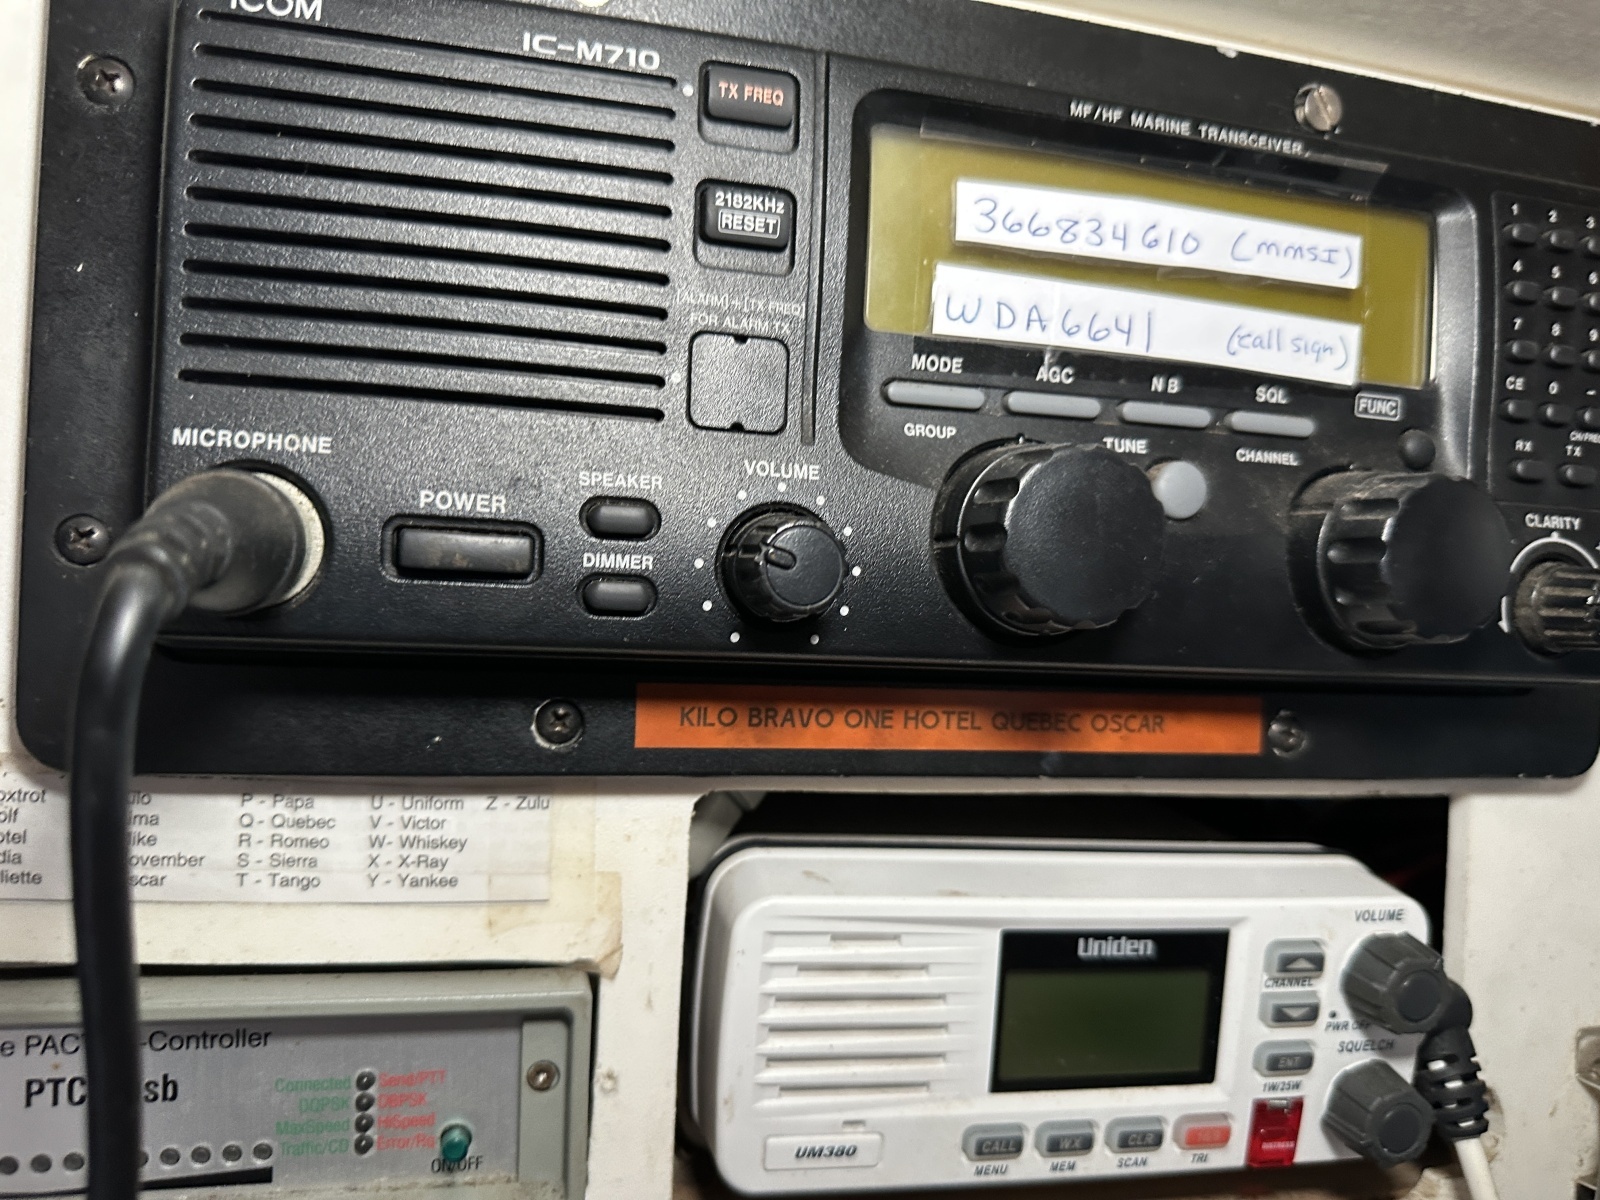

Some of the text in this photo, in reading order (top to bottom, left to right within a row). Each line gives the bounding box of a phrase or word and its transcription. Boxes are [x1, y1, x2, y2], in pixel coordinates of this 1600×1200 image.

[522, 32, 660, 70] IC-M710
[719, 81, 784, 106] TX FREQ
[1130, 109, 1193, 136] MARINE
[1198, 122, 1304, 155] TRANSCEIVER
[1511, 203, 1519, 215] 1
[1548, 209, 1558, 223] 2
[721, 212, 777, 234] RESET
[1586, 216, 1596, 229] 3
[1512, 259, 1523, 272] 4
[1551, 265, 1561, 279] 5
[1589, 271, 1598, 285] 6
[690, 312, 719, 326] FOR
[722, 315, 769, 333] ALARM
[1513, 317, 1523, 330] 7
[1551, 322, 1562, 336] 8
[1589, 328, 1599, 342] 9
[911, 354, 962, 374] MODE
[1035, 366, 1073, 385] AGC
[1506, 375, 1525, 391] CE
[1255, 386, 1287, 405] SQL
[1359, 397, 1395, 416] FUNC
[903, 423, 956, 440] GROUP
[172, 428, 331, 454] MICROPHONE
[1104, 437, 1148, 454] TUNE
[1515, 439, 1533, 452] RX
[1236, 449, 1298, 467] CHANNEL
[1565, 444, 1582, 457] TX
[744, 461, 820, 481] VOLUME
[579, 470, 664, 490] SPEAKER
[420, 491, 506, 514] POWER
[1525, 513, 1581, 531] CLARITY
[582, 552, 654, 571] DIMMER
[680, 706, 1165, 735] KILO BRAVO ONE HOTEL QUEBEC OSCAR
[0, 789, 46, 803] oxtrot
[241, 793, 253, 807] P
[273, 793, 315, 811] Papa
[371, 795, 383, 810] U
[402, 795, 464, 810] Uniform
[485, 796, 498, 810] Z
[516, 796, 550, 810] Zulu
[0, 807, 18, 823] olf
[128, 811, 159, 826] ima
[271, 813, 336, 829] Quebec
[370, 815, 382, 829] V
[400, 815, 447, 830] Victor
[0, 829, 27, 844] otel
[129, 831, 157, 846] ike
[238, 833, 251, 848] R
[271, 833, 330, 849] Romeo
[399, 835, 468, 853] Whiskey
[0, 850, 22, 864] dia
[129, 852, 206, 867] ovember
[238, 853, 249, 867] S
[269, 853, 318, 868] Sierra
[368, 854, 380, 868] X
[398, 854, 449, 871] X-Ray
[0, 870, 42, 884] liette
[129, 874, 167, 886] scar
[236, 872, 248, 887] T
[267, 872, 321, 891] Tango
[368, 873, 379, 888] Y
[398, 873, 458, 888] Yankee
[1354, 909, 1404, 922] VOLUME
[1077, 936, 1155, 958] Uniden
[1264, 977, 1314, 988] CHANNEL
[1338, 1039, 1395, 1054] SQUELCH
[274, 1075, 352, 1092] Connected
[1262, 1080, 1302, 1092] 1W/25W
[982, 1141, 1016, 1153] CALL
[1128, 1134, 1153, 1146] CLR
[794, 1144, 858, 1161] UM380
[1191, 1153, 1208, 1163] TRI
[974, 1164, 1008, 1177] MENU
[1049, 1161, 1075, 1172] MEM
[1117, 1157, 1148, 1169] SCAN
